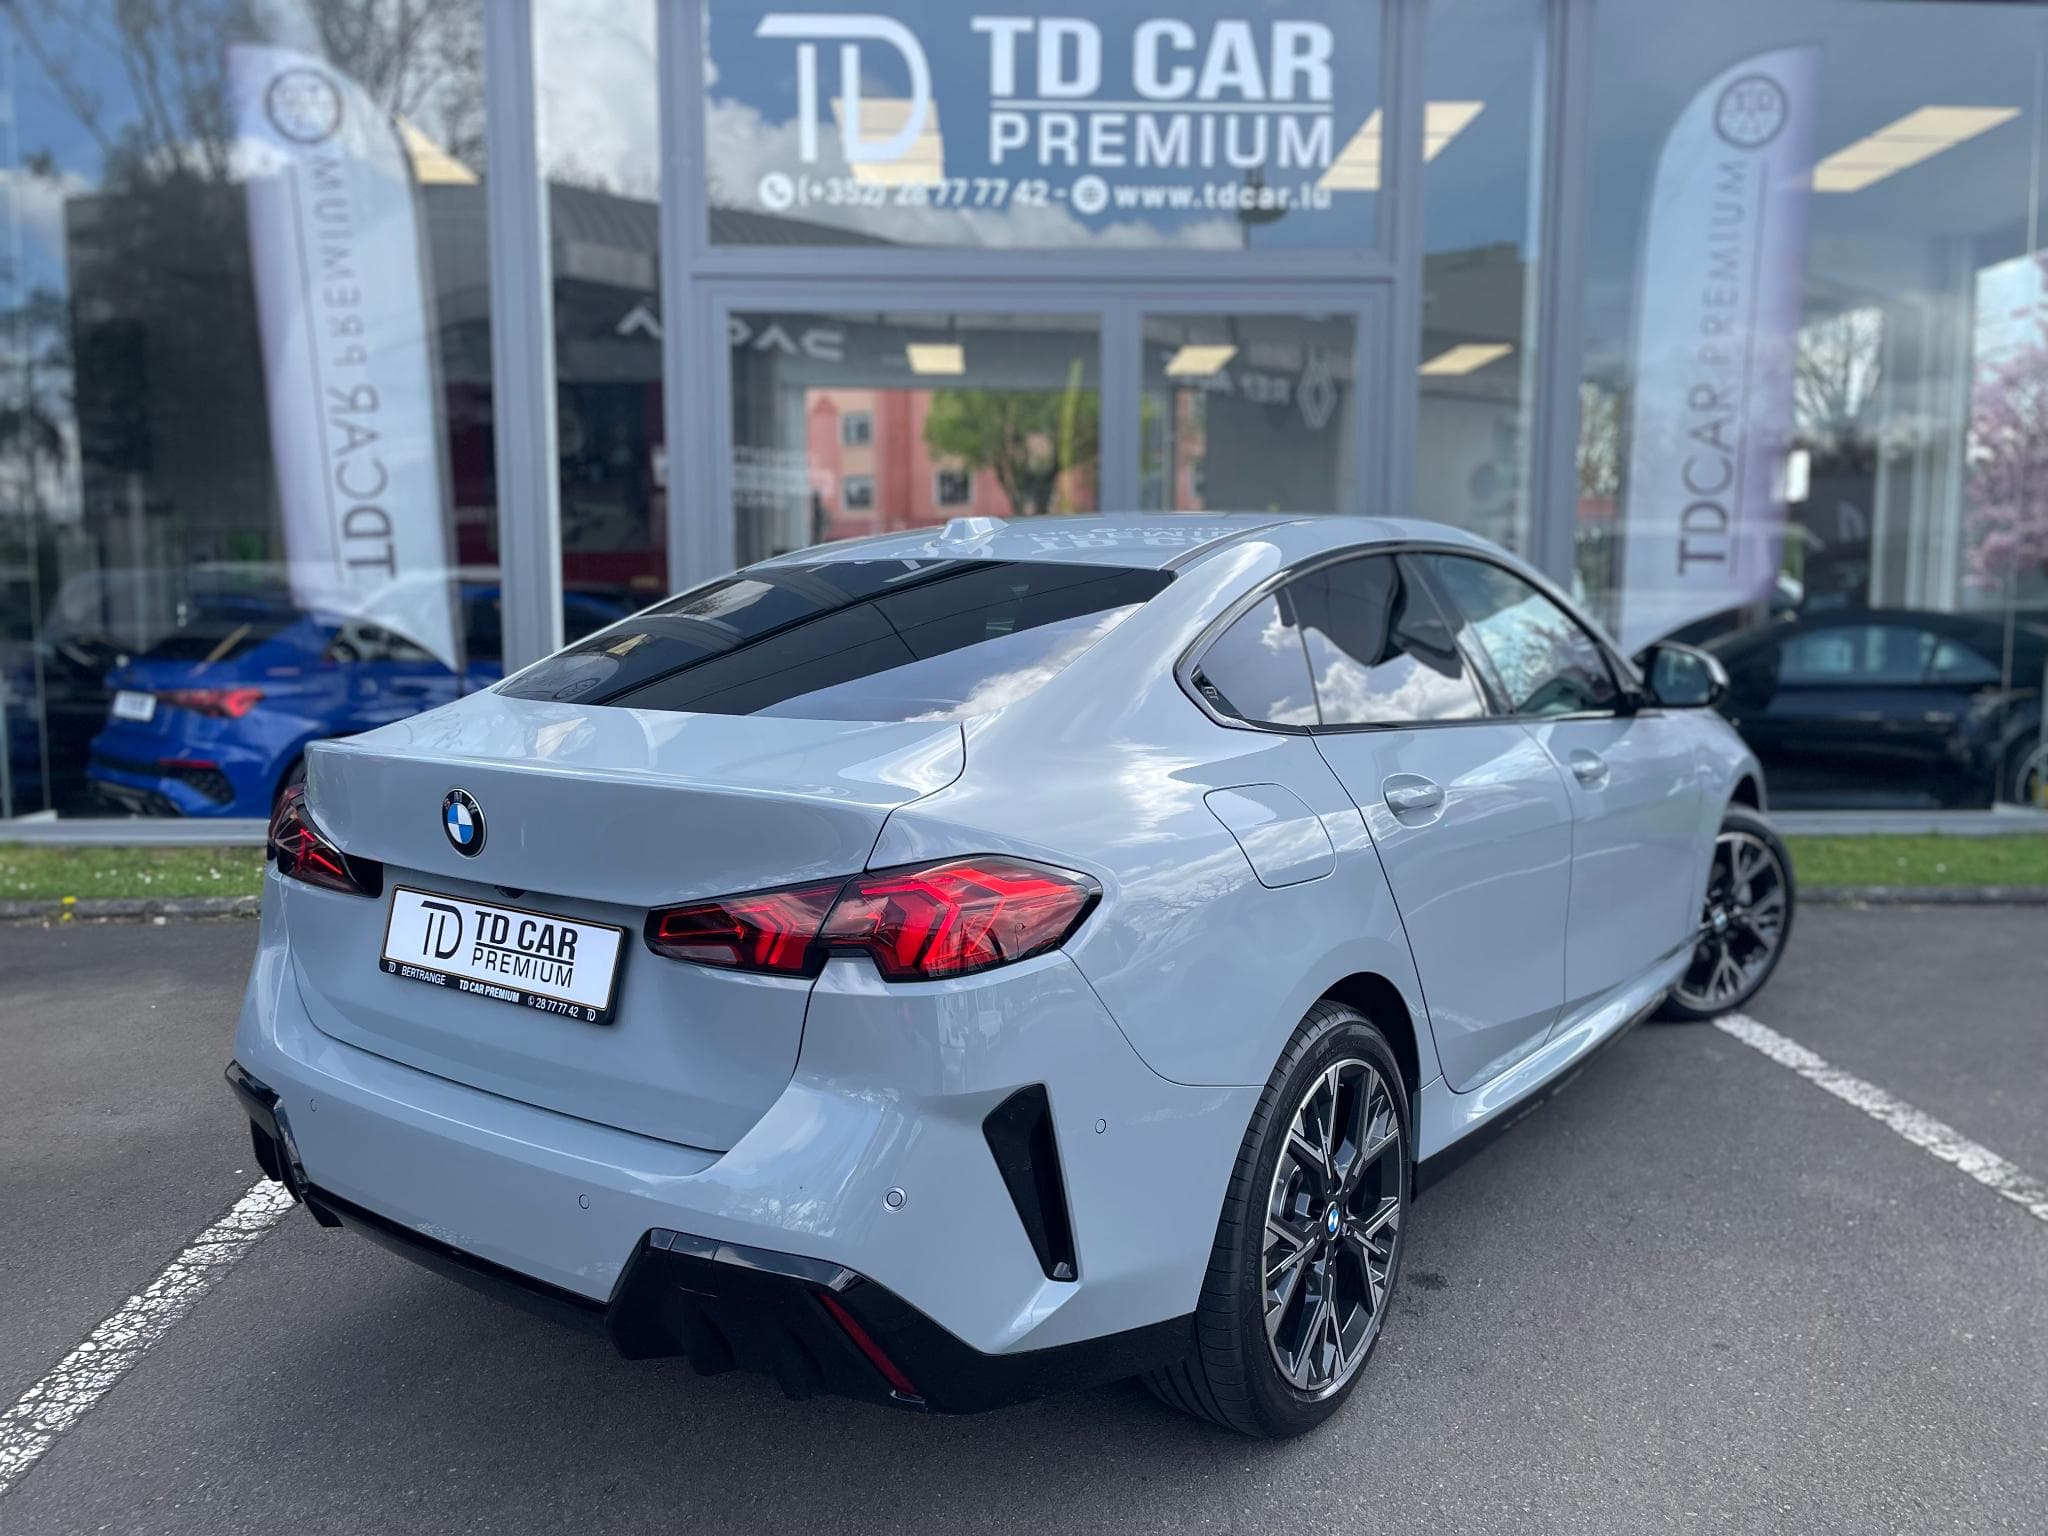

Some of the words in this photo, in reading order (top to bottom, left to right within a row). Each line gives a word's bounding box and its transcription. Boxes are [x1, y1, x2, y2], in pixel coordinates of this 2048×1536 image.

[970, 16, 1101, 98] TD
[1132, 17, 1334, 102] CAR
[989, 111, 1333, 169] PREMIUM
[1112, 180, 1333, 210] www.tdcar.lu
[1697, 160, 1748, 368] PREMIUM
[1676, 382, 1739, 578] TDCAR
[475, 910, 510, 945] TD
[517, 920, 578, 961] CAR
[401, 965, 446, 986] BERTRANGE
[459, 979, 469, 991] TD
[469, 981, 484, 996] CAR
[484, 985, 520, 1003] PREMIUM
[536, 997, 546, 1009] 28
[547, 1000, 557, 1012] 77
[557, 1002, 568, 1015] 77
[568, 1005, 579, 1018] 42
[471, 947, 574, 988] PREMIUM
